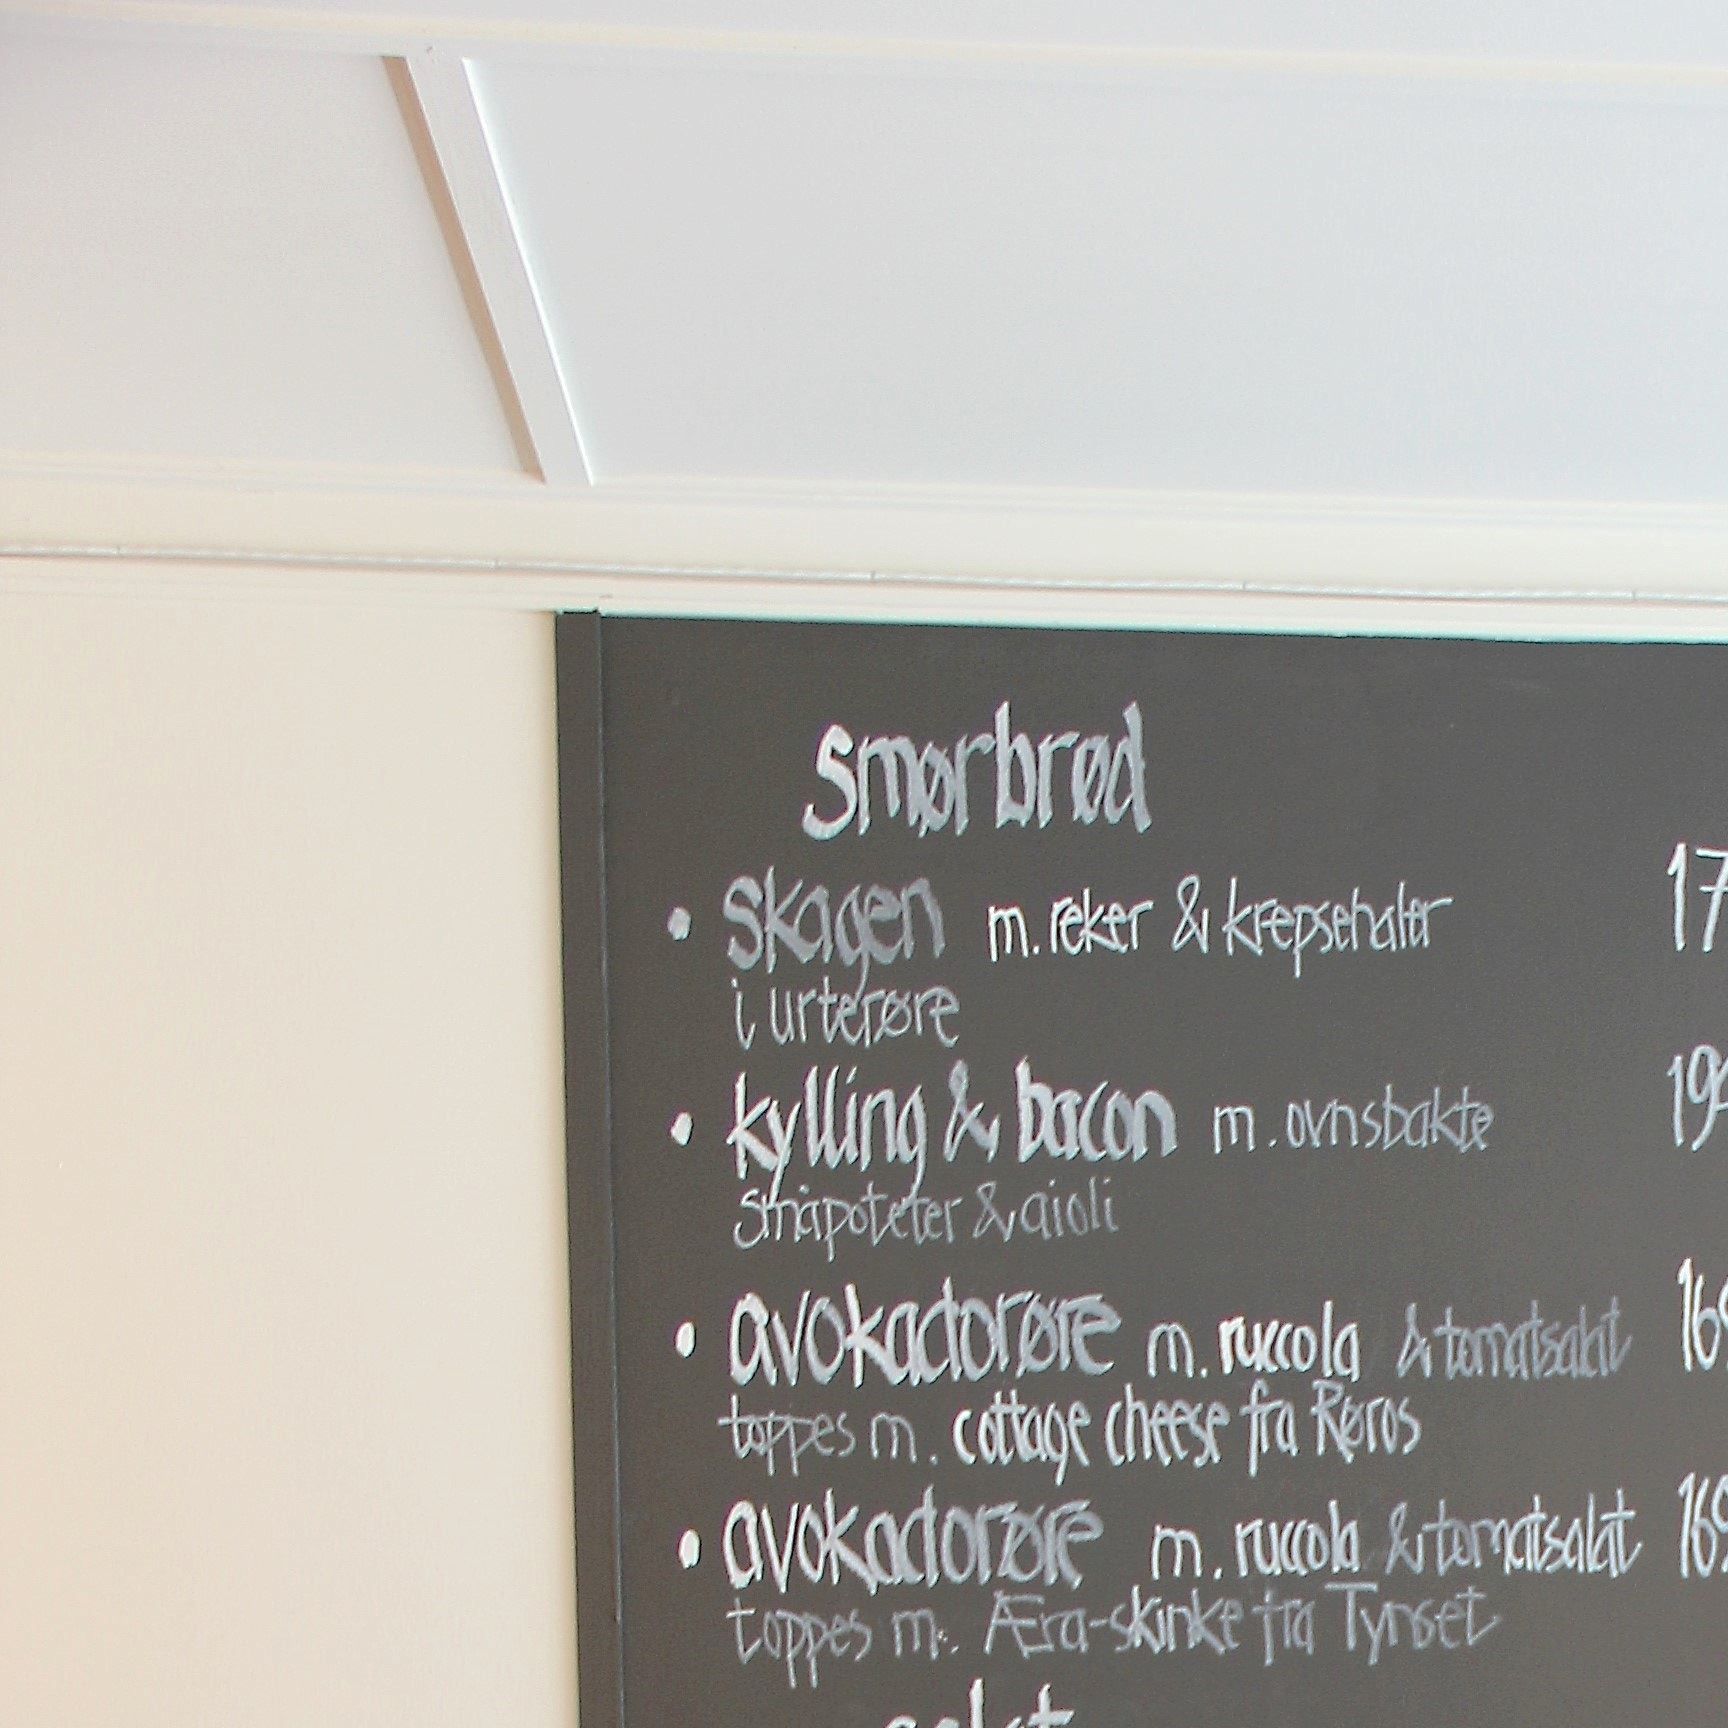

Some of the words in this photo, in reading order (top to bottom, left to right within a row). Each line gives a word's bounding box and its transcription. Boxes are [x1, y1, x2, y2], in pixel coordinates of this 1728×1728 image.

[802, 700, 1150, 840] smørbrød
[1172, 875, 1208, 955] &
[730, 978, 756, 1050] i
[727, 1070, 928, 1203] kylling
[944, 1058, 999, 1162] &
[1016, 1055, 1177, 1162] bacon
[972, 1181, 1015, 1243] &
[1020, 1177, 1119, 1238] aioli
[729, 1276, 1122, 1386] avokadorøre
[1240, 1378, 1298, 1476] fra
[722, 1484, 1104, 1596] avokadorøre
[1253, 1586, 1315, 1665] fra
[1325, 1580, 1500, 1665] Tynset
